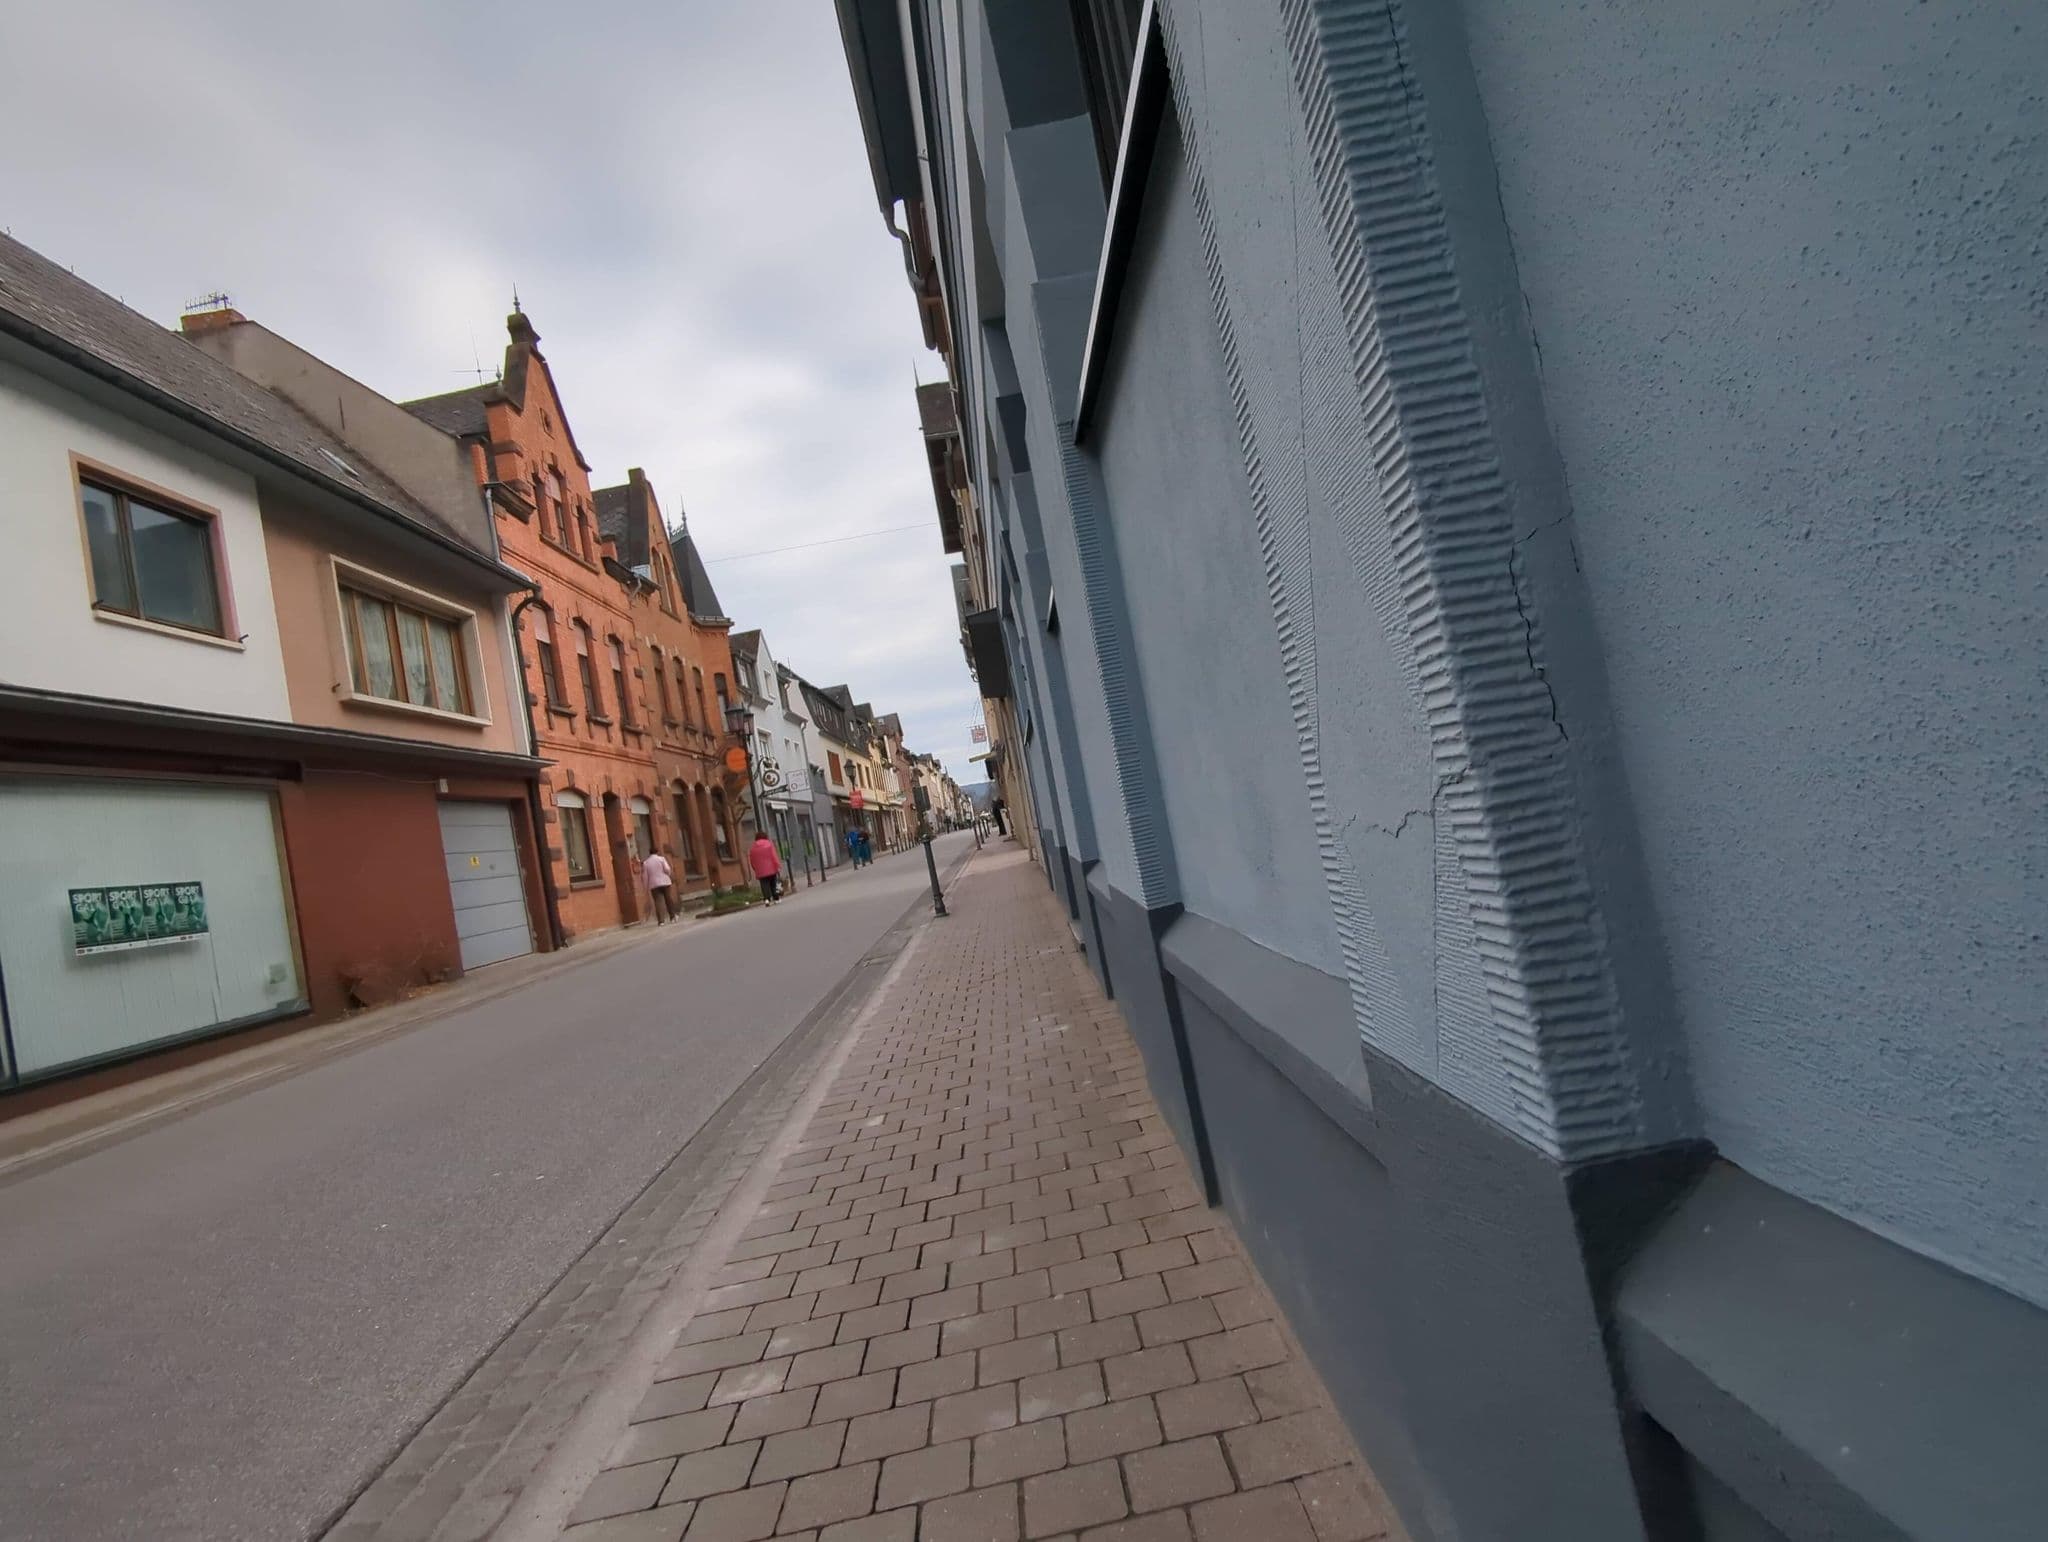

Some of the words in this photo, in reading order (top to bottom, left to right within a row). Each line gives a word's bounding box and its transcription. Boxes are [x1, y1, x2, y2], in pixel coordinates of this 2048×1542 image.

[108, 890, 138, 902] SPORT
[143, 887, 170, 899] SPORT
[175, 885, 200, 896] SPORT
[72, 892, 102, 904] SPORT
